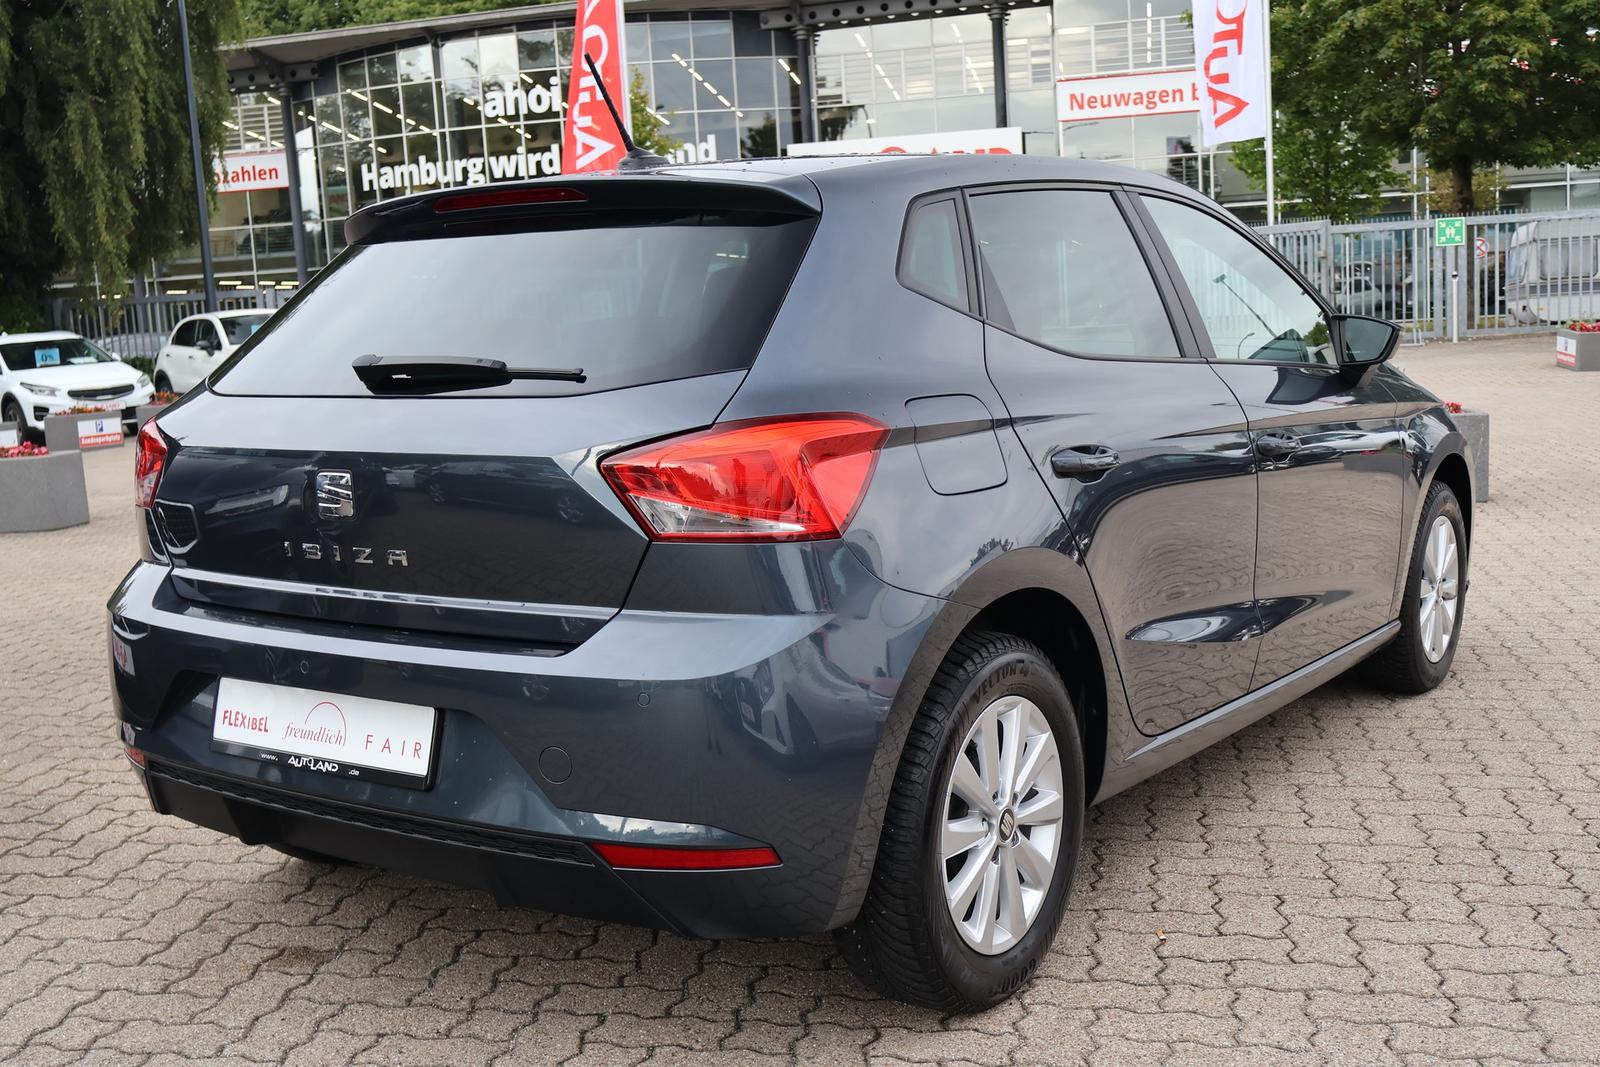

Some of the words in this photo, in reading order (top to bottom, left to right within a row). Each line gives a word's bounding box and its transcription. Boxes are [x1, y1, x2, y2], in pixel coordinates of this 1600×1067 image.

[484, 76, 561, 118] ahoi
[1069, 88, 1184, 110] Neuwagen
[361, 154, 485, 192] Hamburg
[489, 145, 562, 179] wird
[284, 541, 408, 566] IBIZA
[222, 709, 269, 733] FLEXIBEL
[282, 721, 343, 746] freundlich
[288, 755, 338, 772] AUTOLAND
